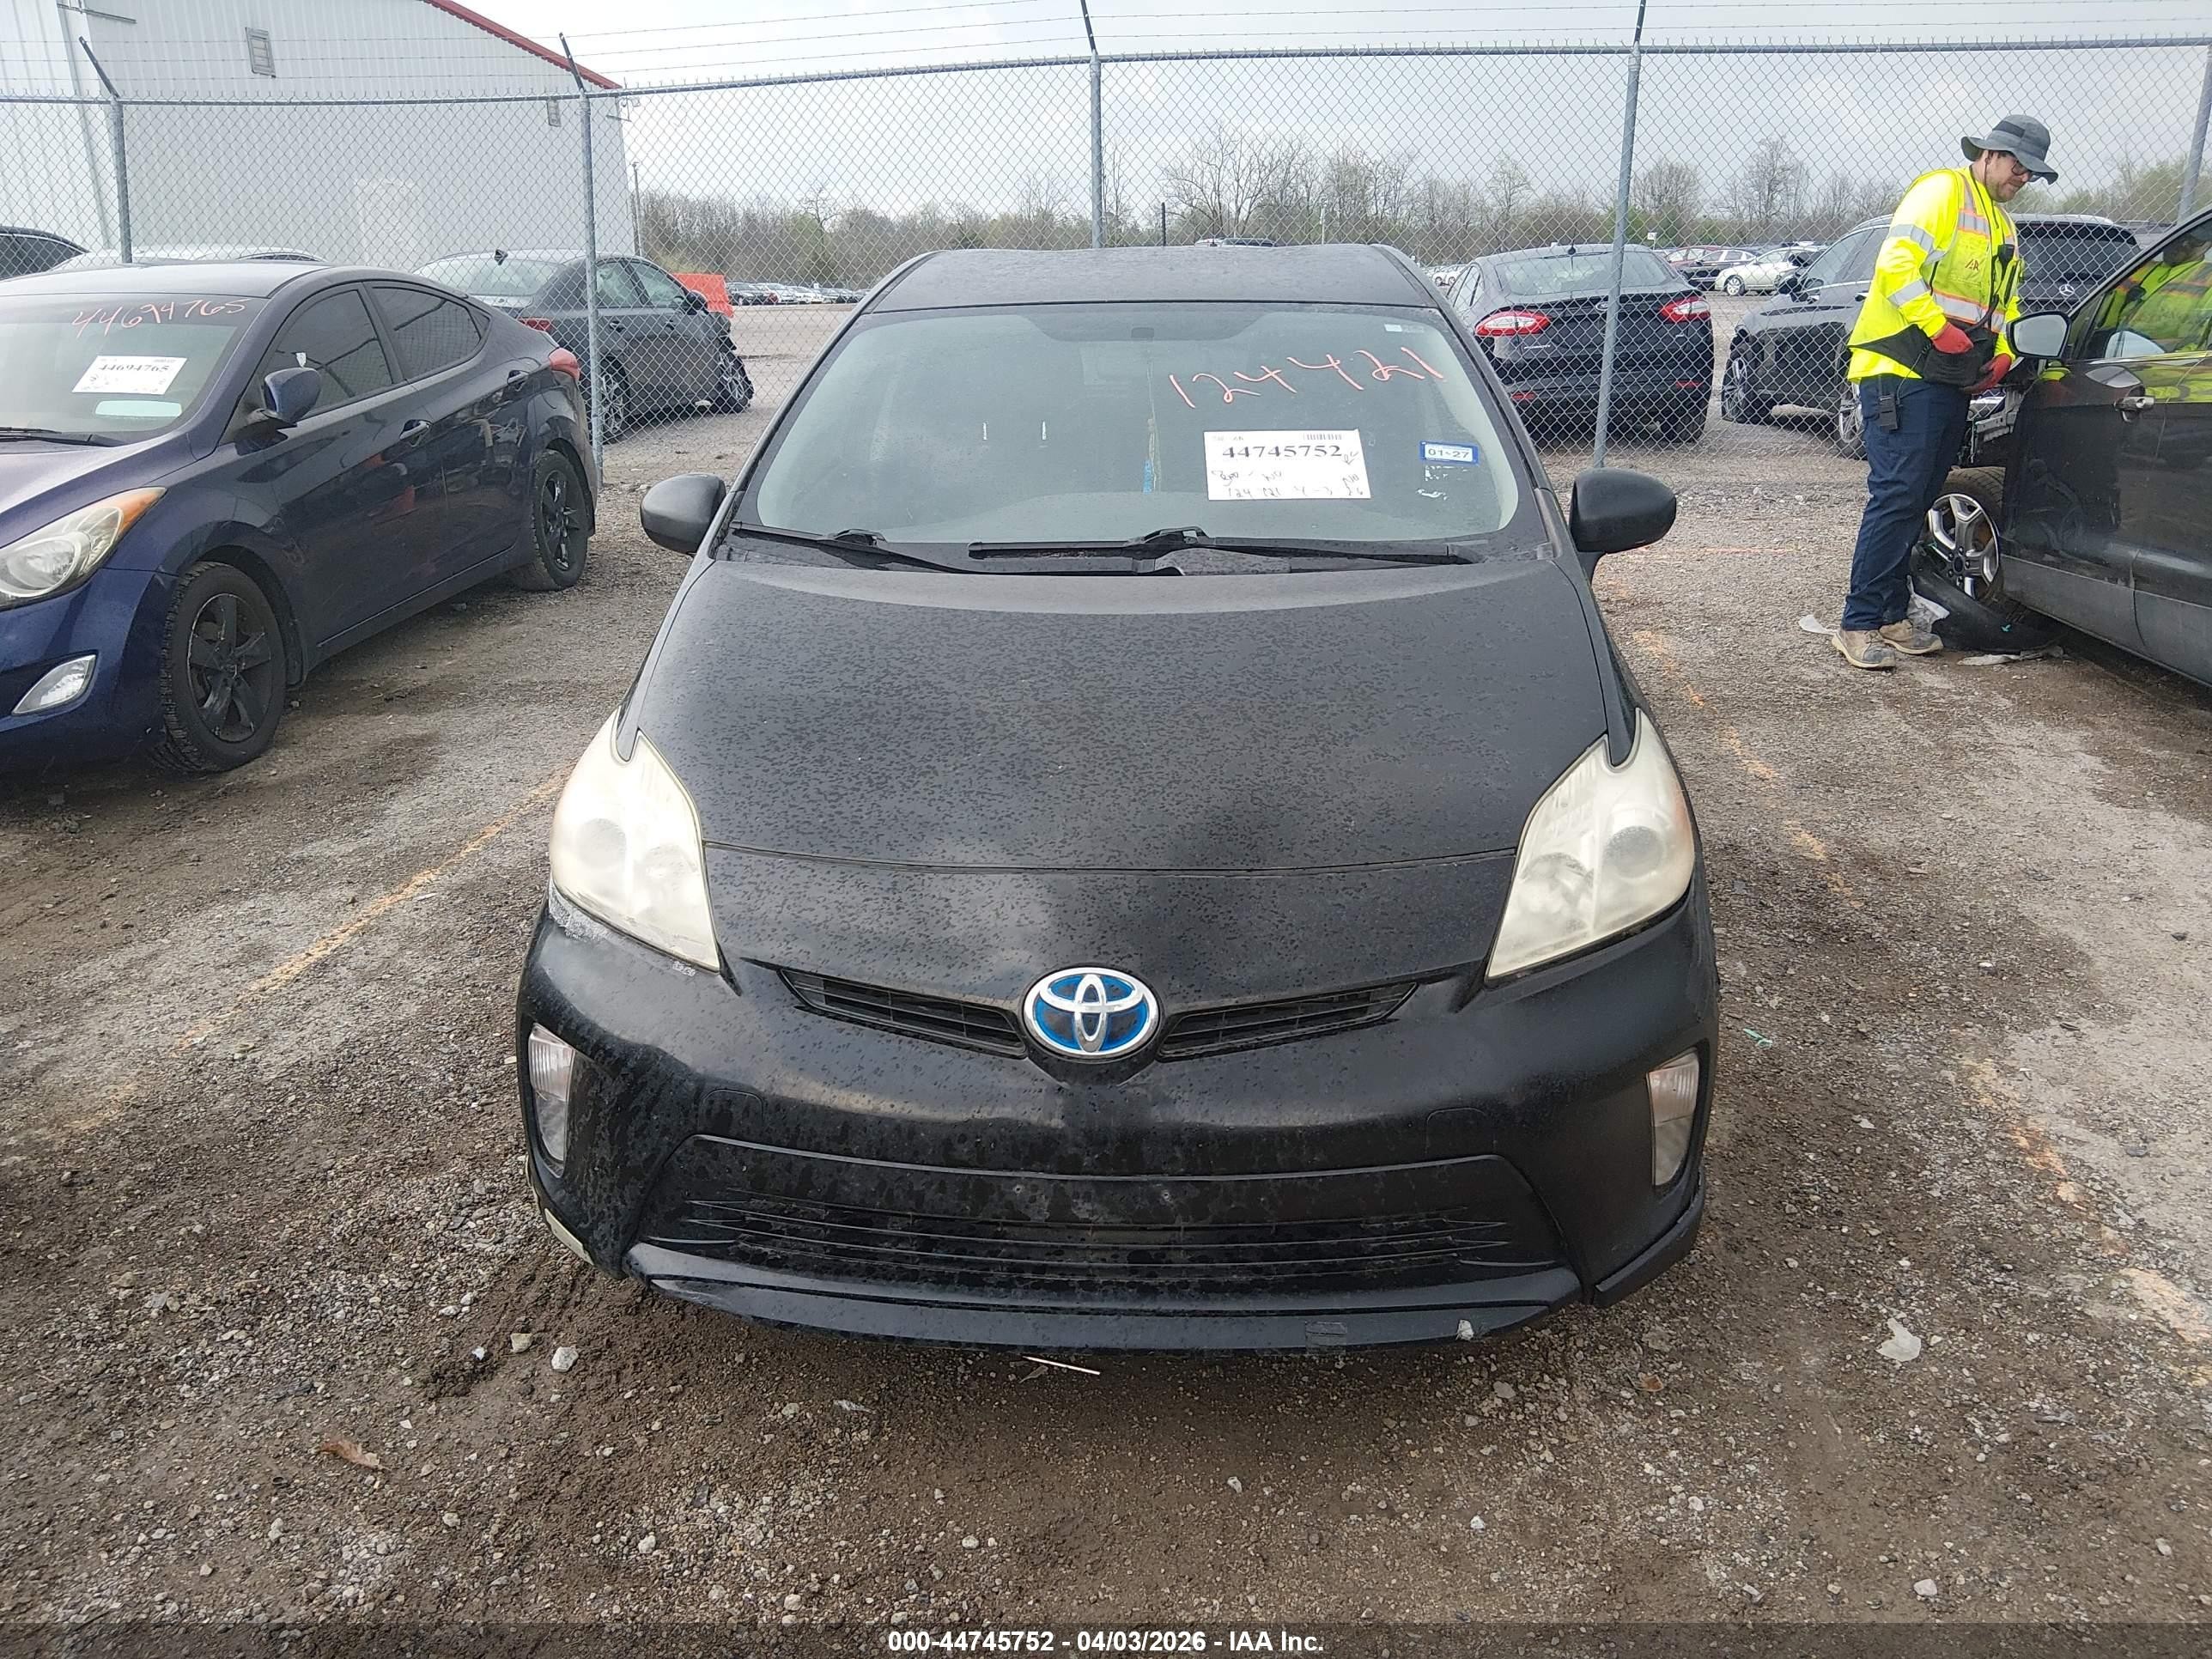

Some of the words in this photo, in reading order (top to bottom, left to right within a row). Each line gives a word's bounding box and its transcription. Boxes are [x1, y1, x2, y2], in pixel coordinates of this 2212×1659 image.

[72, 298, 252, 339] 44694765
[1222, 445, 1342, 458] 44745752
[1428, 448, 1470, 459] 01-27
